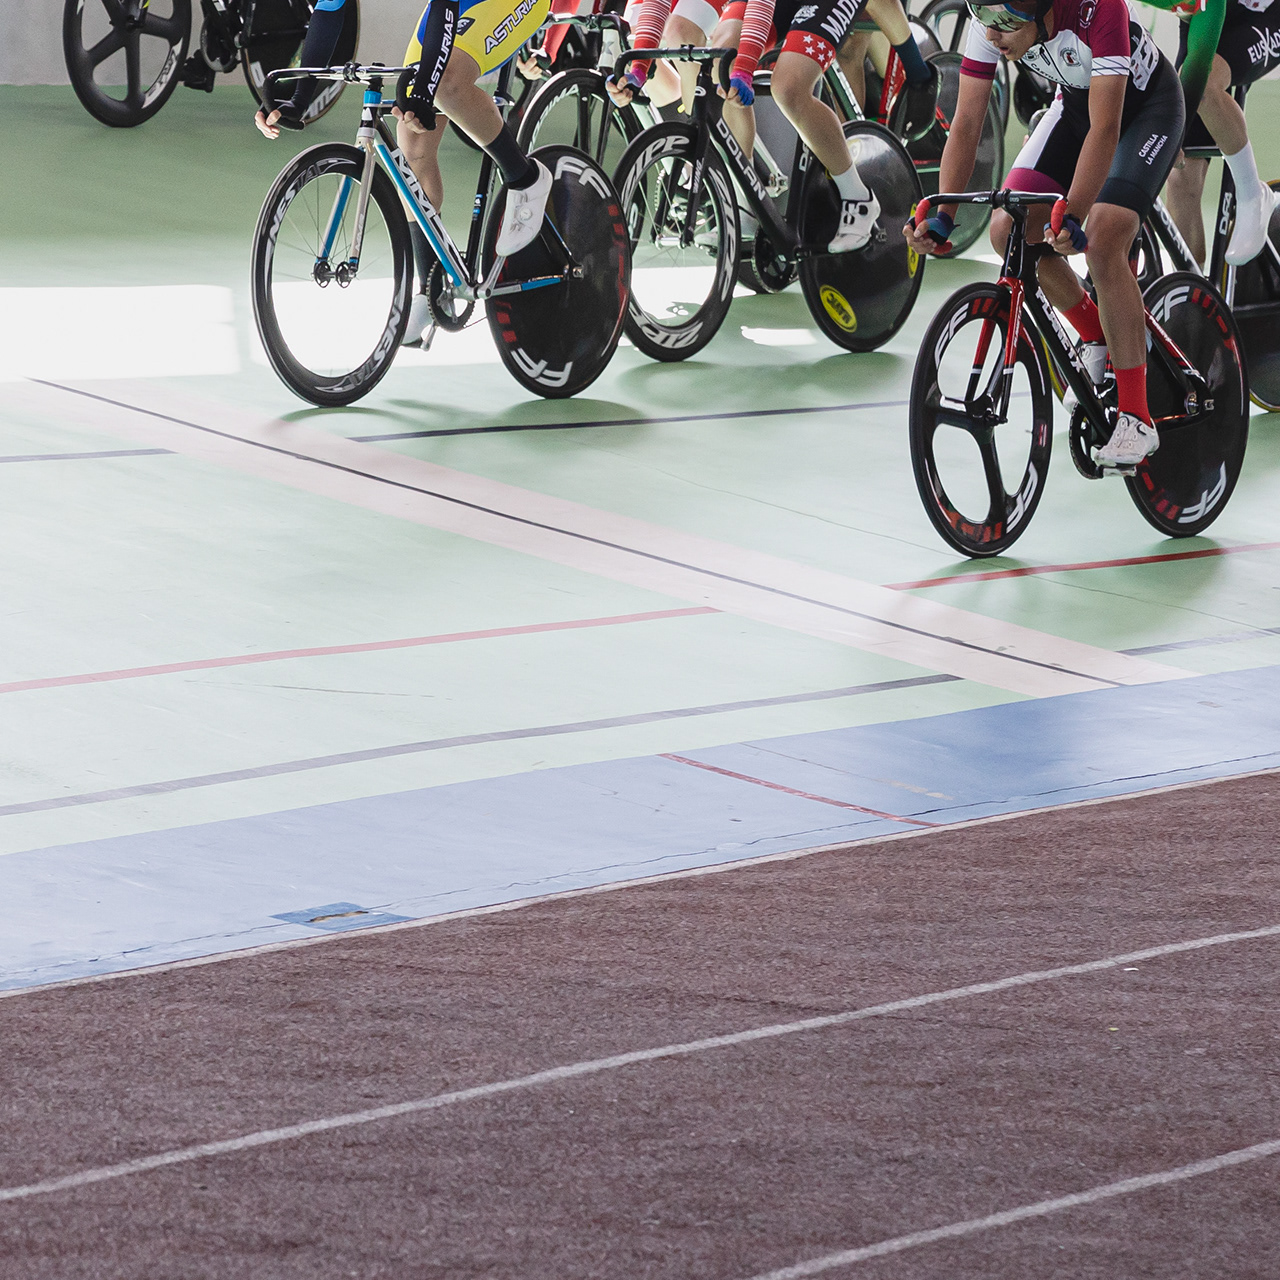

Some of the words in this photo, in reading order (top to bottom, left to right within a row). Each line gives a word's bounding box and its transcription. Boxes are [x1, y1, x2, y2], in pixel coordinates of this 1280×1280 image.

[427, 8, 455, 96] ASTURIAS
[716, 118, 766, 202] DOLAN
[1138, 133, 1159, 158] CASTILLA
[1145, 156, 1154, 166] LA
